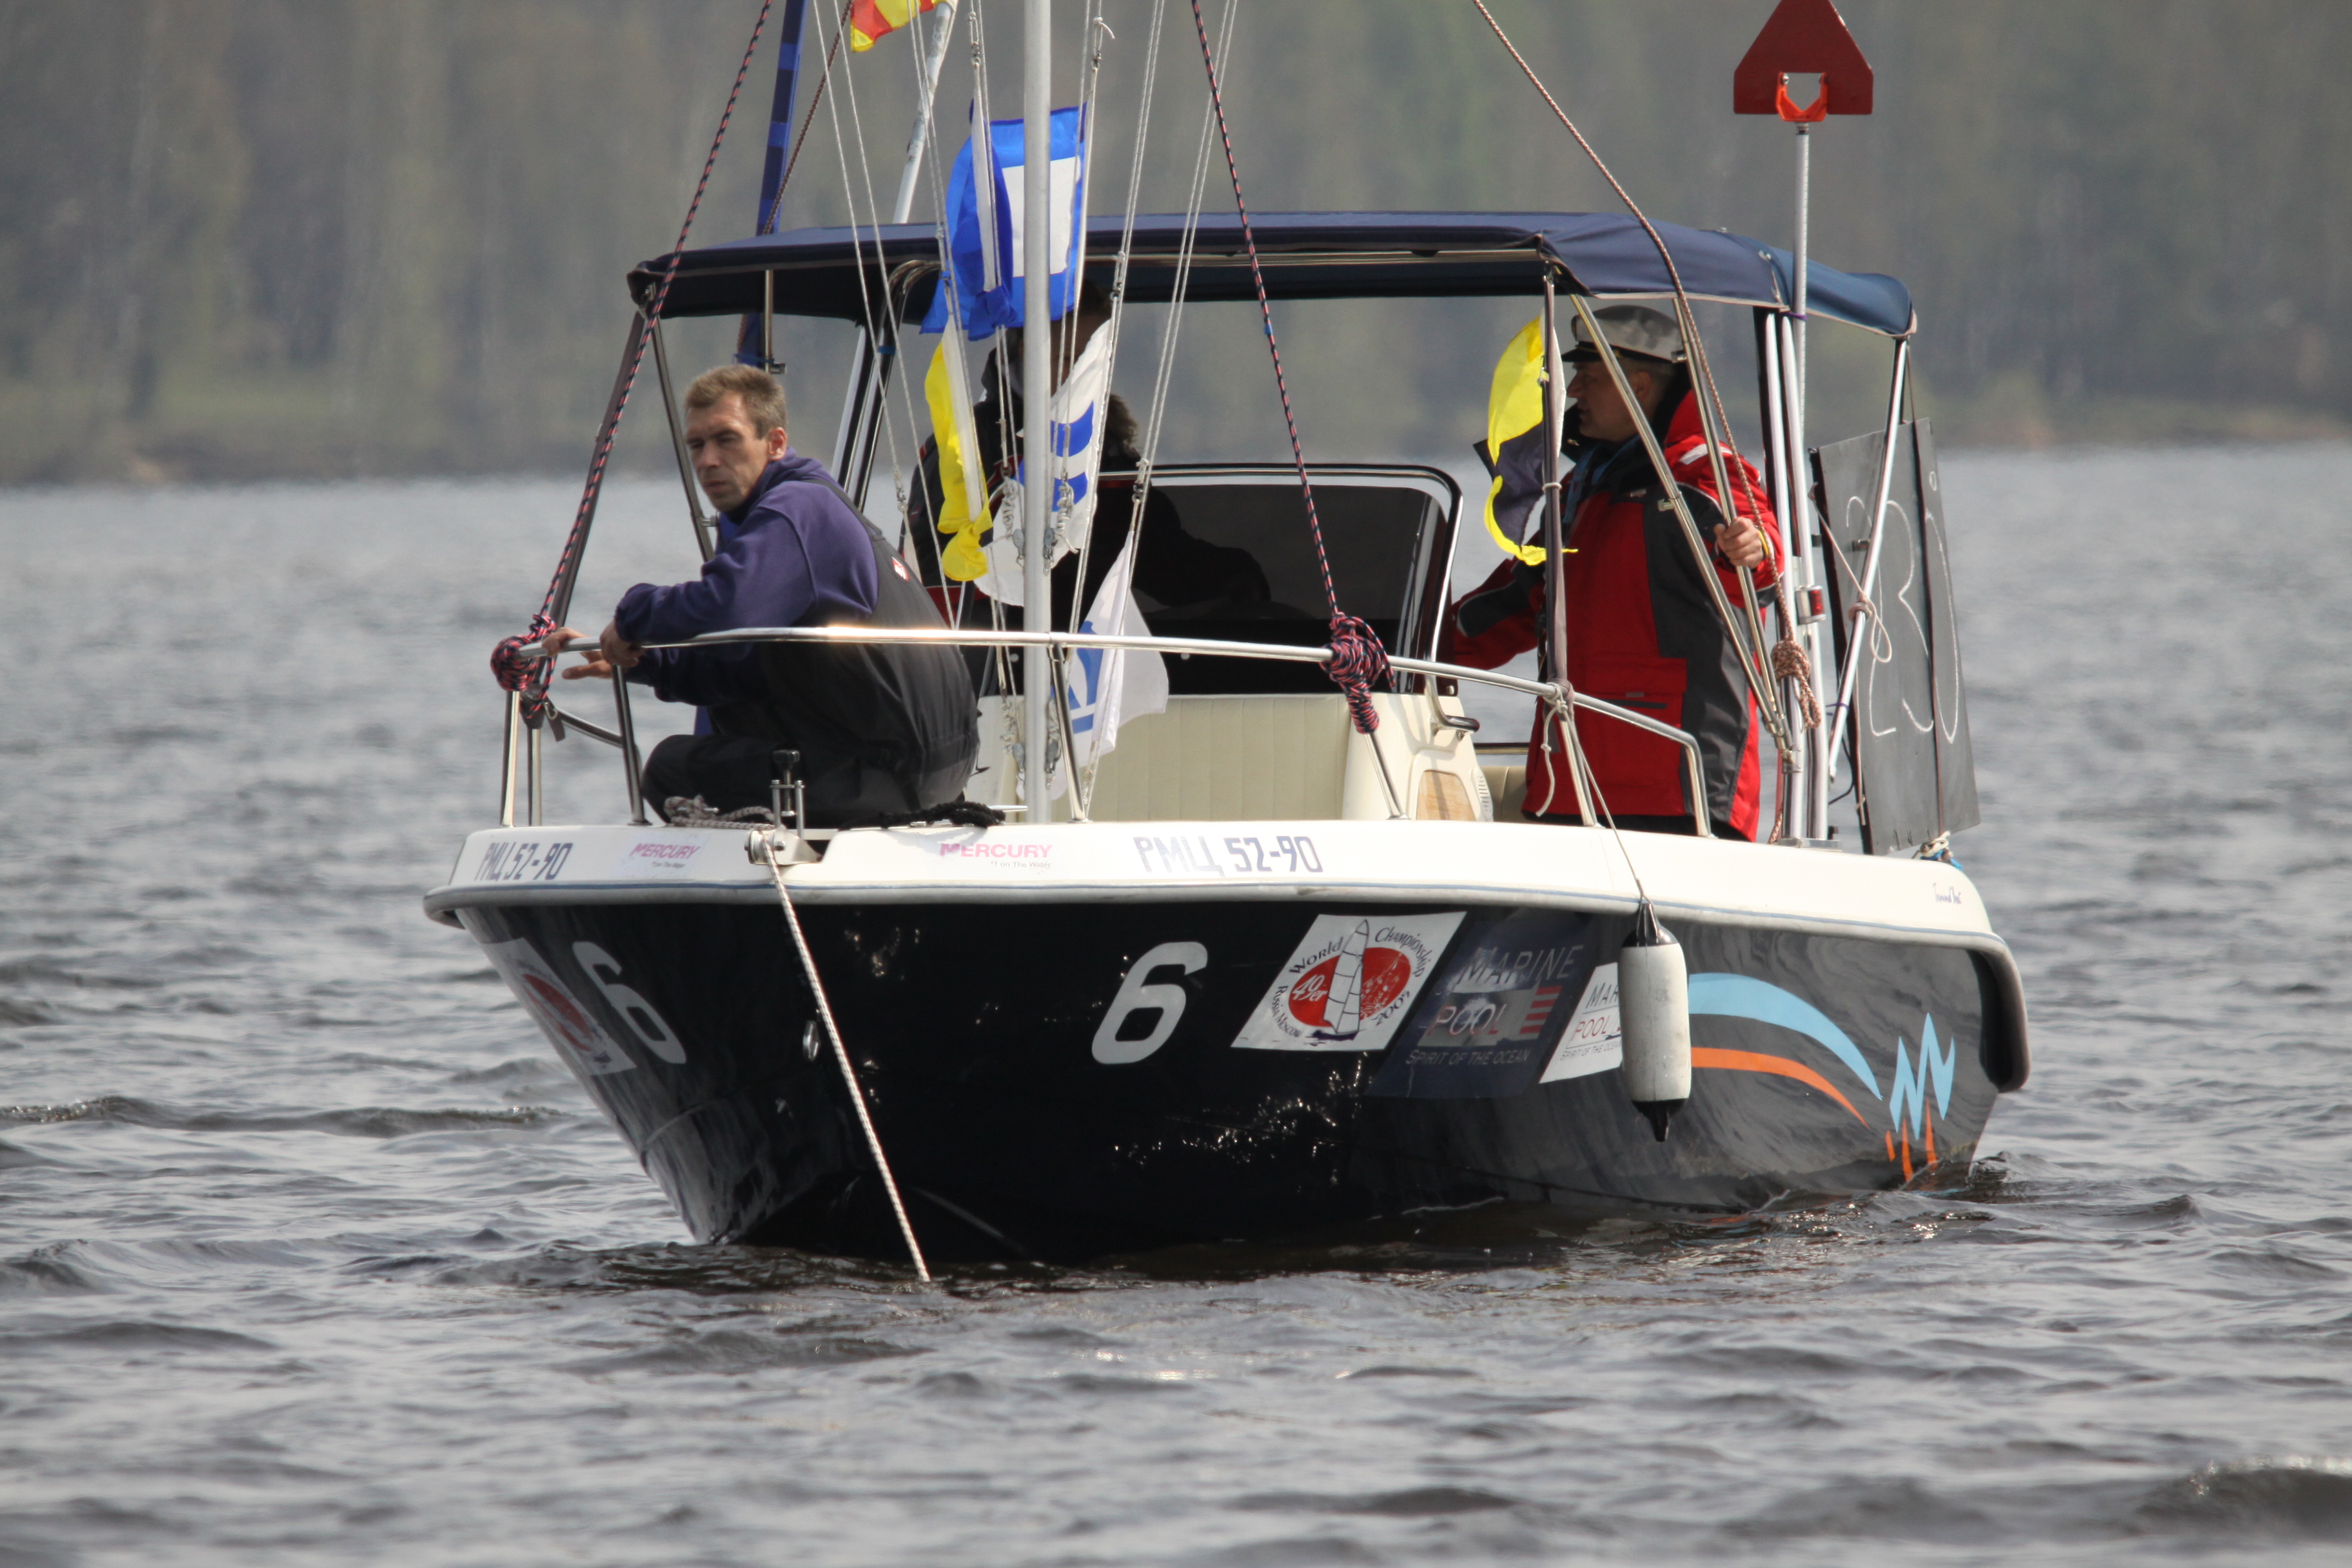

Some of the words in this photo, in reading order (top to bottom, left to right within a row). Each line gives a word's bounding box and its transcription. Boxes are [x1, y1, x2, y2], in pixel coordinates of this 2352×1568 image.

[503, 843, 574, 881] 52-90
[628, 843, 701, 859] MERCURY
[939, 843, 1052, 858] MERCURY
[1029, 861, 1051, 869] Water
[1132, 836, 1226, 877] РМЦ
[1223, 836, 1323, 872] 52-90
[1289, 936, 1344, 974] World
[1375, 926, 1433, 977] Championship
[1455, 944, 1584, 985] MARINE
[572, 941, 687, 1064] 6
[1092, 941, 1209, 1065] 6
[1292, 974, 1329, 1002] 49er
[1427, 1003, 1507, 1036] POOL
[1570, 1015, 1611, 1041] POOL
[1405, 1048, 1450, 1066] SPIRIT
[1448, 1051, 1468, 1066] OF
[1467, 1051, 1494, 1066] THE
[1492, 1048, 1532, 1065] OCEAN
